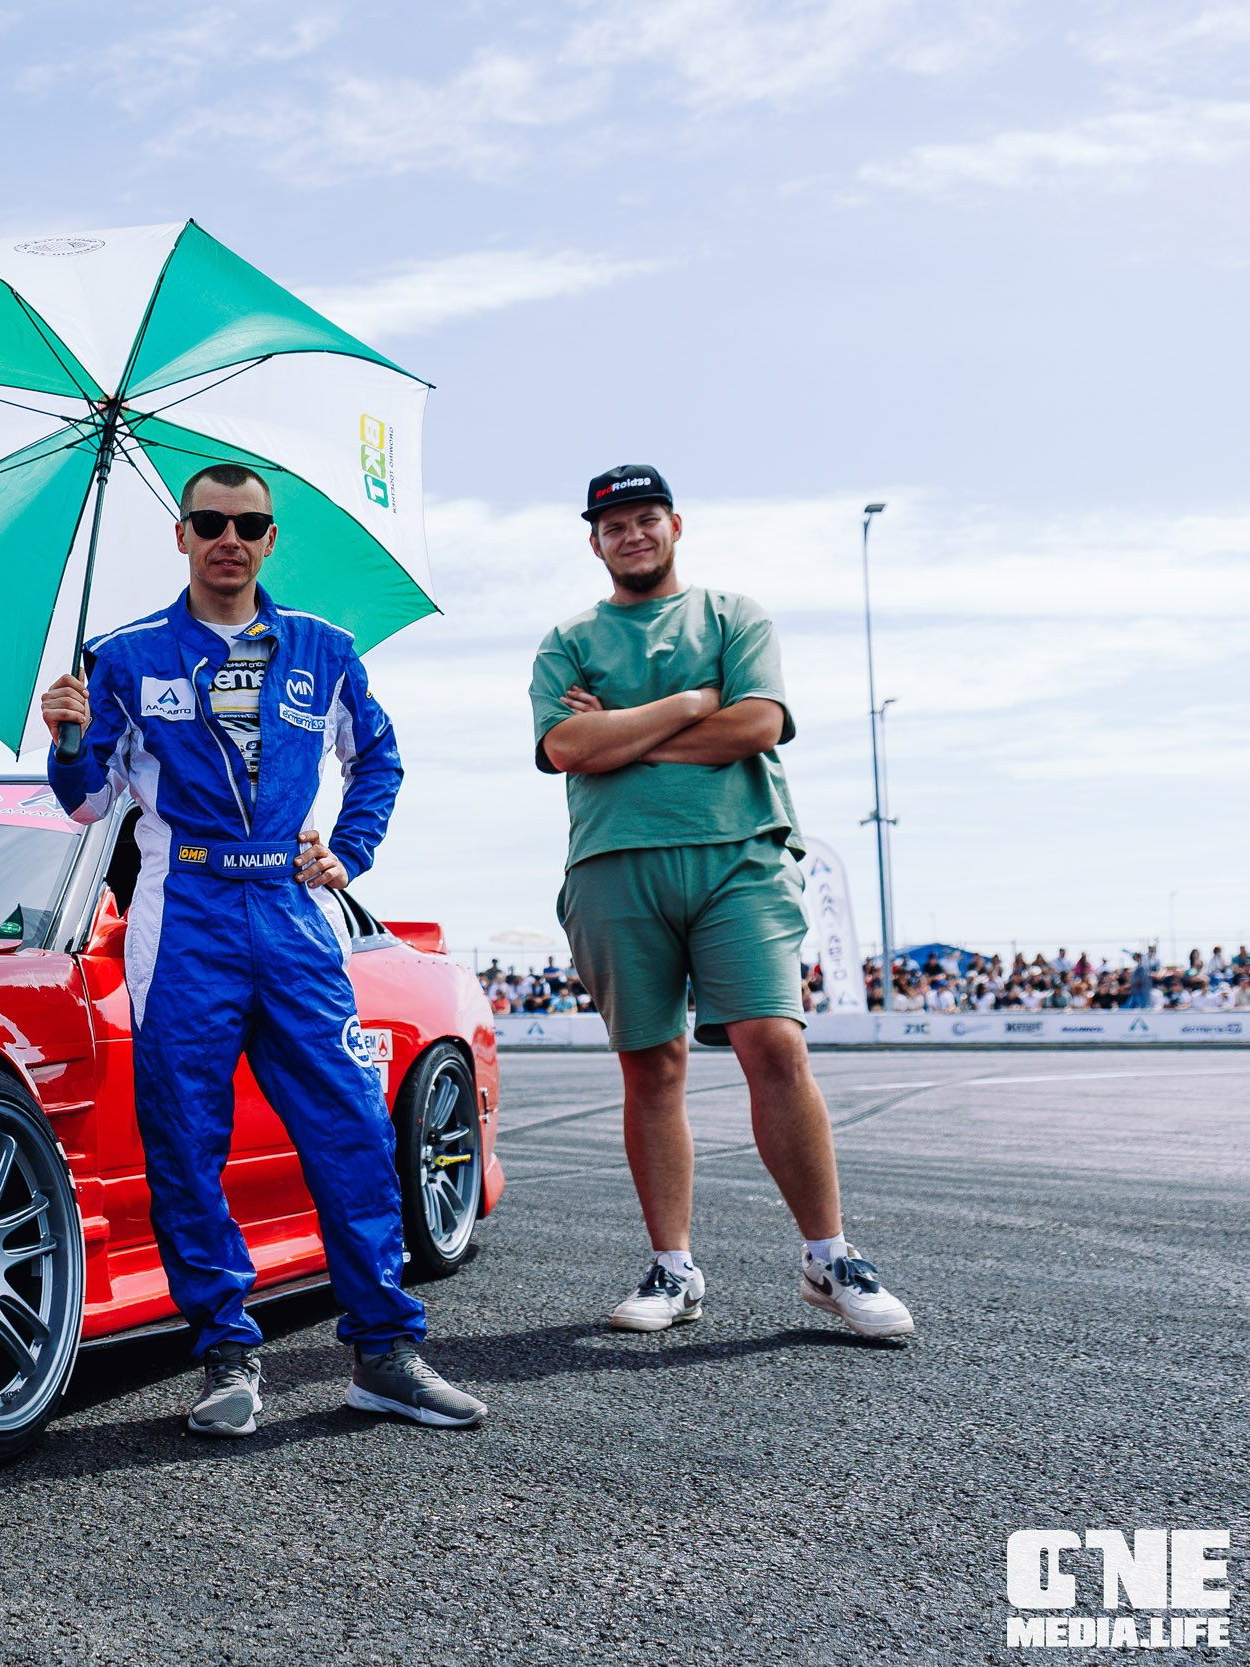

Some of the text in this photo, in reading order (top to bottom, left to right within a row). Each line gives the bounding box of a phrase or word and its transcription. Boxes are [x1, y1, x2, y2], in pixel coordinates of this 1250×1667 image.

[181, 848, 206, 861] OMP
[223, 853, 288, 867] M. NALIMOV
